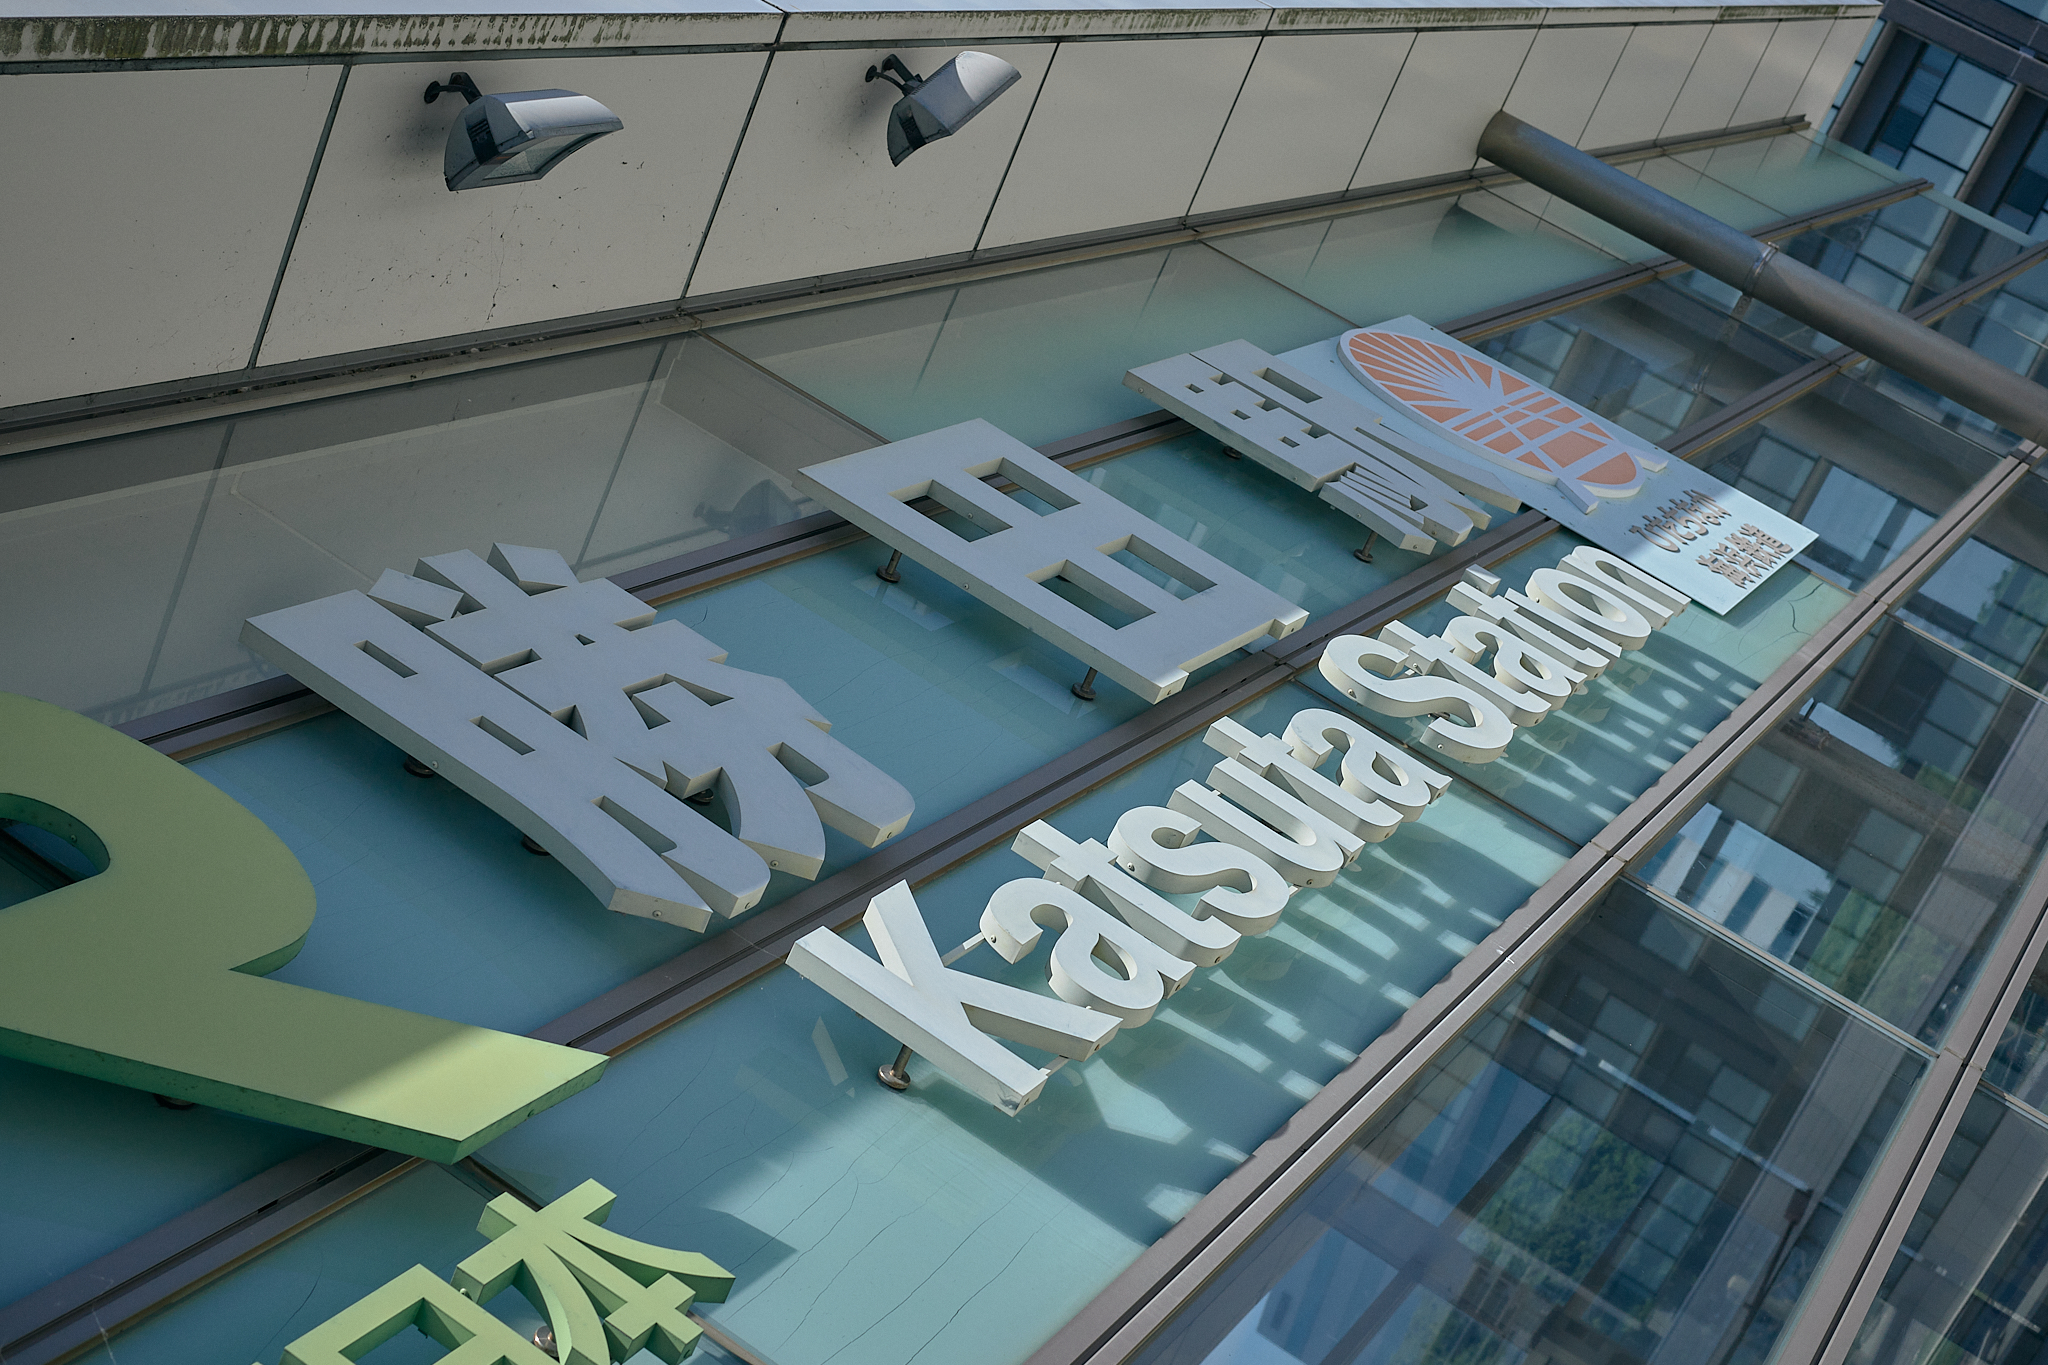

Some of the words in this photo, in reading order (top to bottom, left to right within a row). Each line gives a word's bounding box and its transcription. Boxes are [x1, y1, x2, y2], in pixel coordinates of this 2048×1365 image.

[240, 338, 1522, 932] 勝田駅
[1629, 489, 1732, 553] ひたちなか
[1695, 523, 1793, 590] 海浜鉄道
[785, 708, 1452, 1118] Katsuta
[1318, 545, 1692, 764] Station
